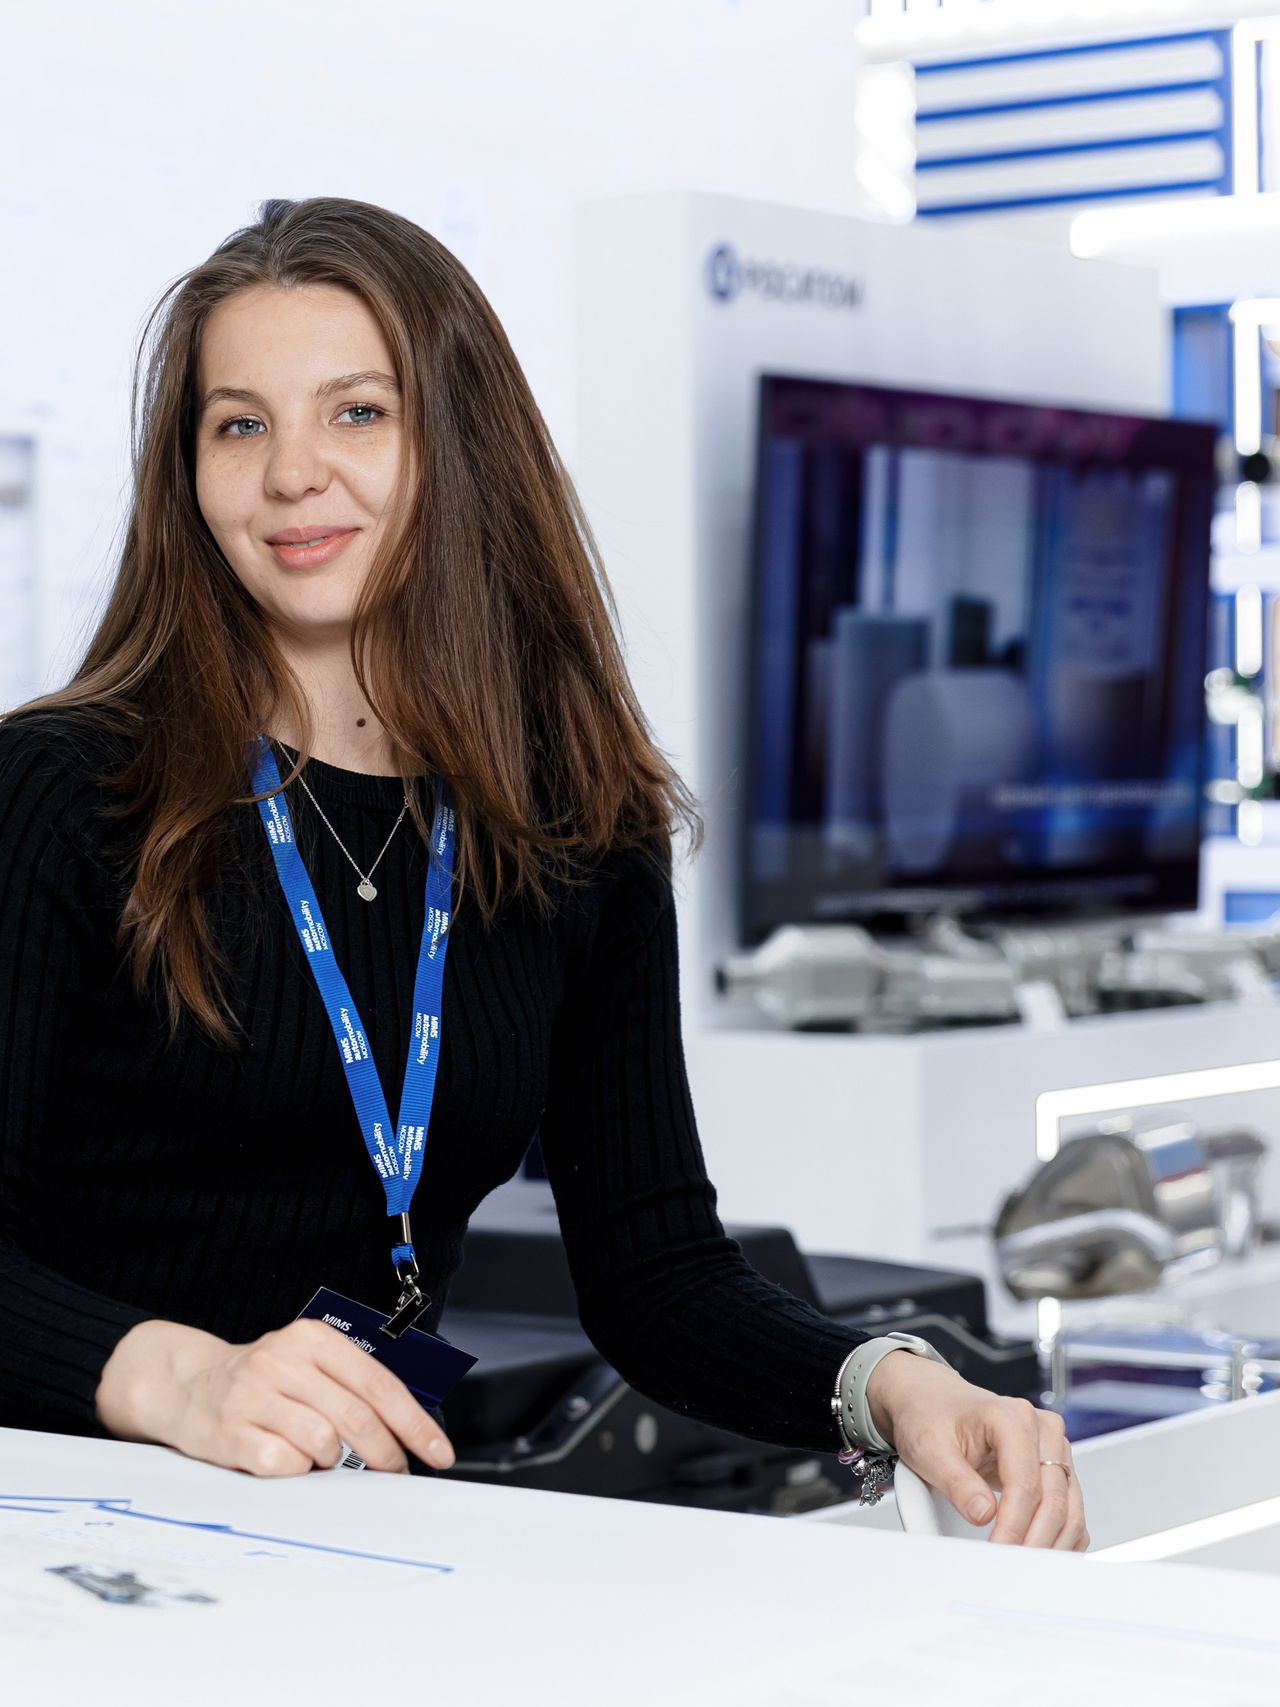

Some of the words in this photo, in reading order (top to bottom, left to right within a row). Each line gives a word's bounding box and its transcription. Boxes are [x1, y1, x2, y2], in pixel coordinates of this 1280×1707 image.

[266, 820, 279, 844] MIMS
[267, 795, 286, 843] automobilit
[281, 815, 292, 843] MOSCOW
[436, 806, 449, 856] automobility
[300, 900, 322, 951] automobility
[316, 922, 329, 950] MOSCOW
[301, 929, 316, 952] MIMS
[340, 1007, 362, 1061] automobility
[416, 1013, 430, 1065] automobility
[430, 1015, 439, 1039] MIMS
[340, 1037, 354, 1064] MIMS
[355, 1030, 369, 1059] MOSCOW
[373, 1122, 395, 1176] automobility
[398, 1124, 407, 1154] MOSCOW
[403, 1125, 415, 1180] automobility
[413, 1126, 425, 1151] MIMS
[373, 1153, 389, 1178] MIMS
[387, 1145, 400, 1175] MOSCOW
[322, 1313, 352, 1331] MIMS
